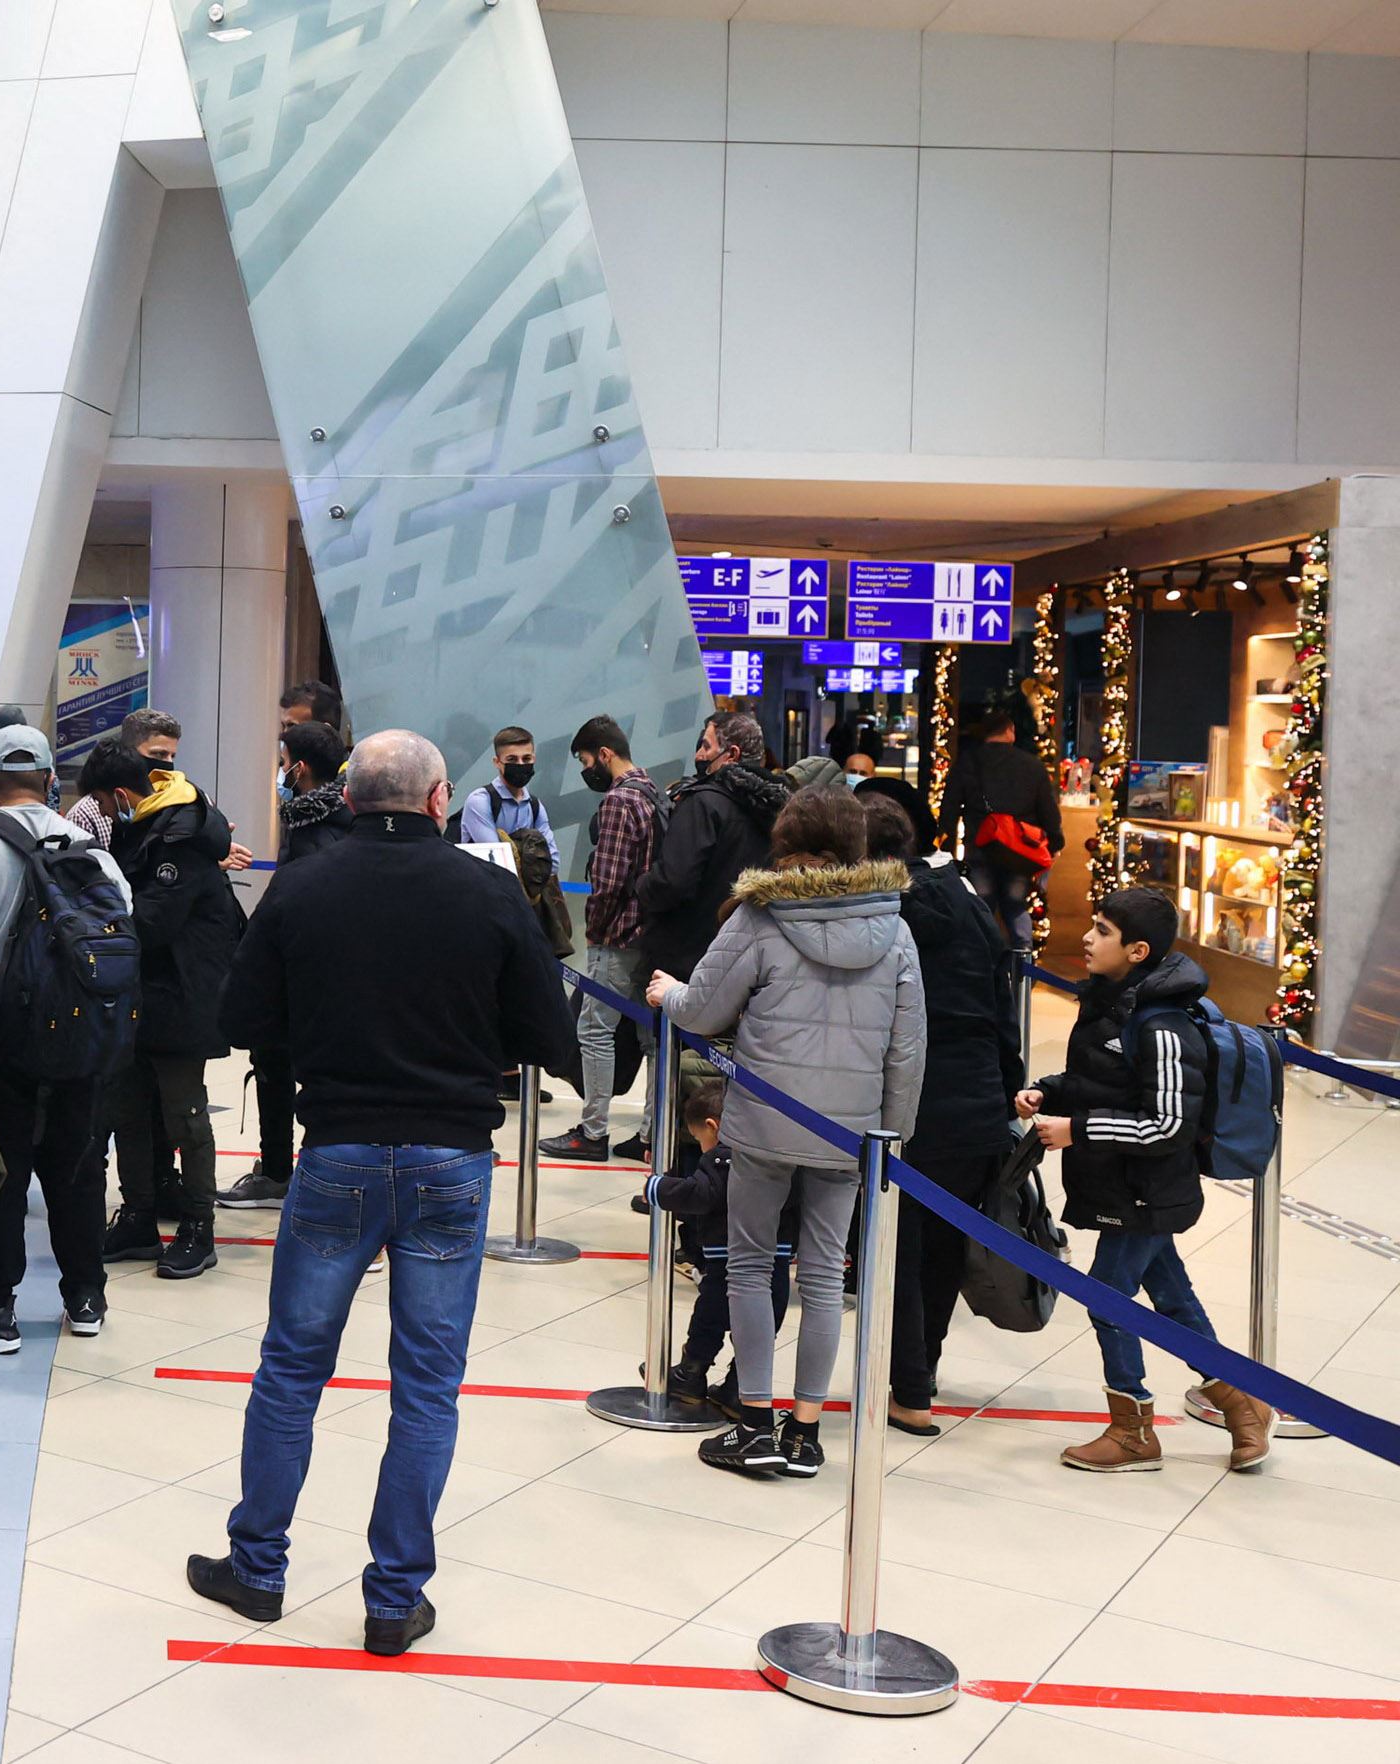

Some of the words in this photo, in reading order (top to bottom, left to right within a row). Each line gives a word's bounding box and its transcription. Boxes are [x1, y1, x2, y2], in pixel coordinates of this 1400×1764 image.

[713, 568, 743, 587] E-F
[708, 1046, 737, 1079] SECURITY
[723, 1439, 739, 1447] SPORT
